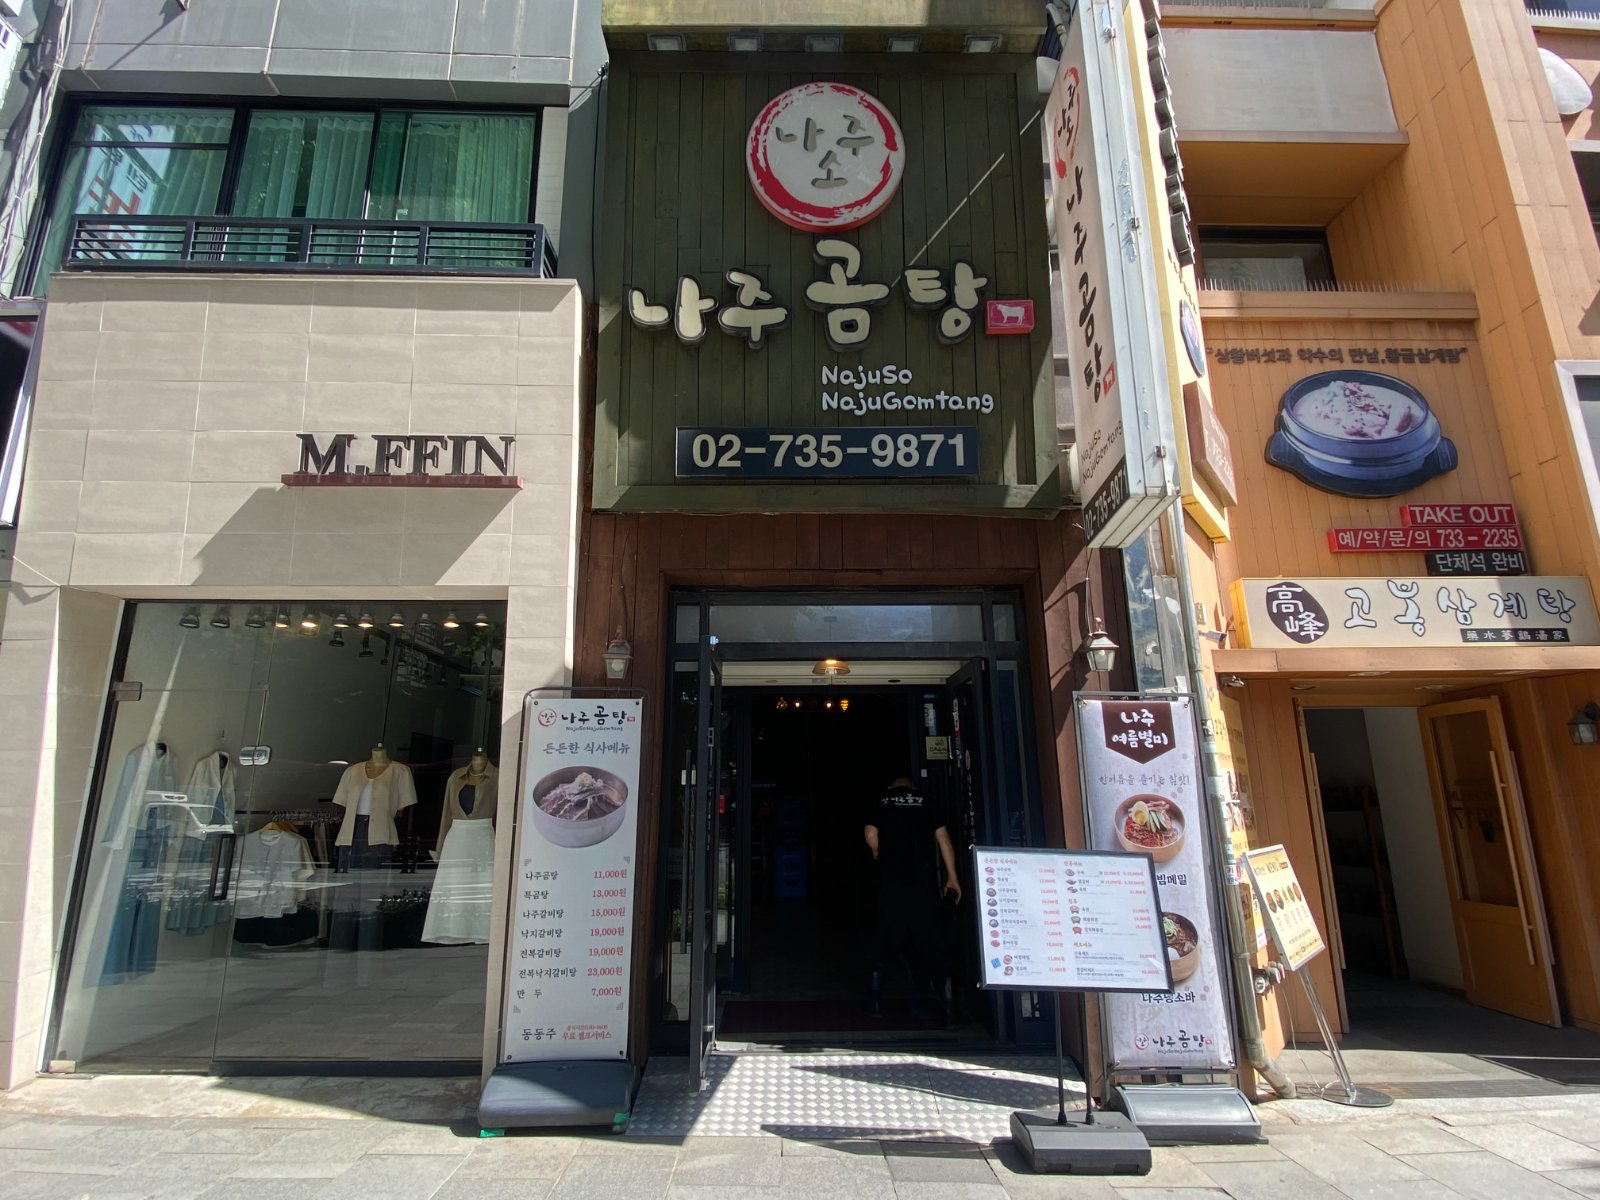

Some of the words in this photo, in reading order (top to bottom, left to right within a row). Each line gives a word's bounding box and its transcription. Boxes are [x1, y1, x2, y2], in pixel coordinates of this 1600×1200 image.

[775, 113, 874, 157] 나주
[811, 150, 848, 189] 소
[628, 239, 990, 351] 나주곰탕
[821, 365, 913, 390] NajuSo
[821, 391, 995, 416] NajuGomtang
[293, 433, 516, 476] M.FFIN
[692, 434, 966, 469] 02-735-9871
[1409, 506, 1465, 524] TAKE
[1469, 505, 1511, 523] OUT
[1338, 529, 1431, 548] 예/약/문/의
[1435, 552, 1487, 573] 단체석
[1492, 551, 1526, 572] 완비
[561, 705, 628, 725] 나주곰탕
[1120, 708, 1155, 727] 나주
[543, 742, 580, 755] 든든한
[583, 741, 630, 755] 식사메뉴
[1112, 729, 1168, 748] 여름별미
[525, 871, 559, 881] 나주곰탕
[593, 870, 628, 879] 11,000원
[522, 909, 564, 919] 나주갈비탕
[591, 907, 626, 917] 15,000원
[521, 929, 563, 939] 낙지갈비탕
[519, 948, 562, 959] 전복갈비탕
[518, 968, 577, 979] 전복낙지갈비탕
[591, 986, 622, 997] 7,000원
[521, 1028, 557, 1041] 동동주
[1152, 1029, 1205, 1048] 나주곰탕
